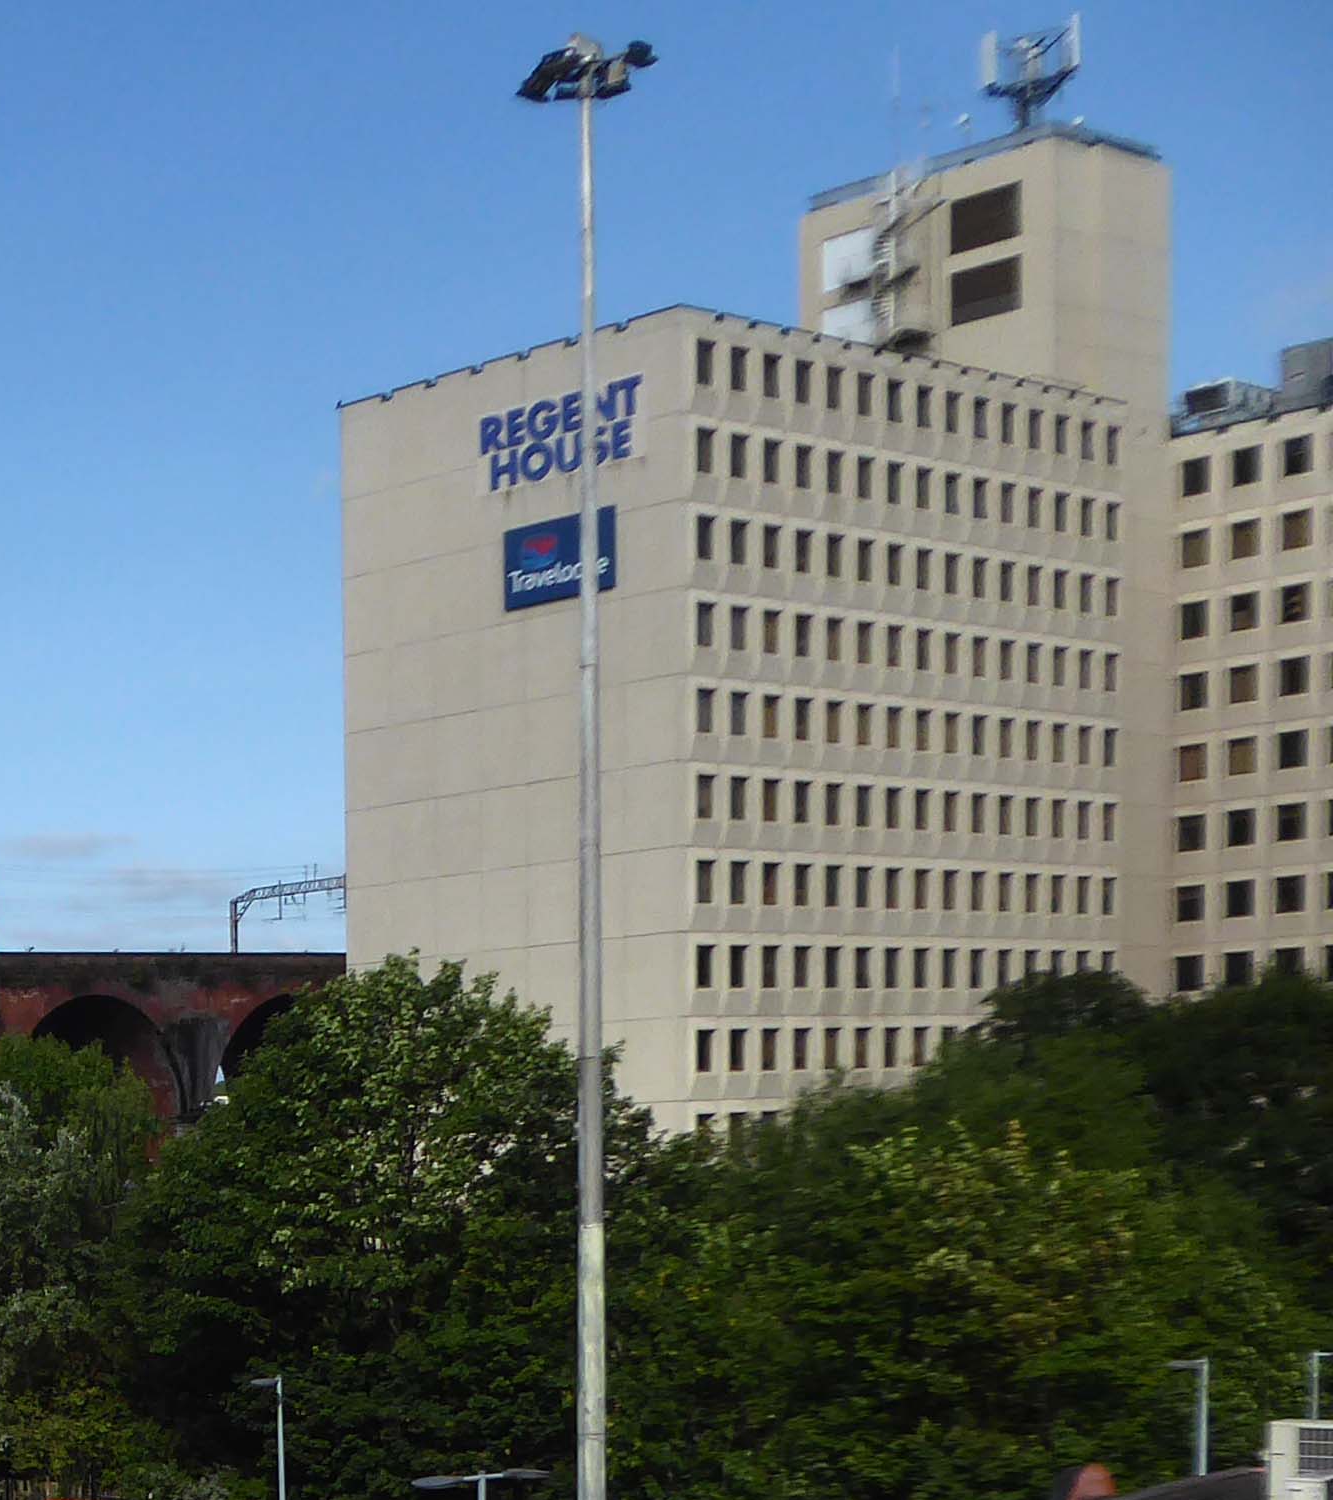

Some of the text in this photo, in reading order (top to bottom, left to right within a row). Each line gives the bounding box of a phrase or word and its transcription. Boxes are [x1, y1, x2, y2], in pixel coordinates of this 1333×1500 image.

[479, 373, 644, 456] REGENT
[490, 418, 632, 491] HOUSE
[506, 556, 611, 593] Traveloe
